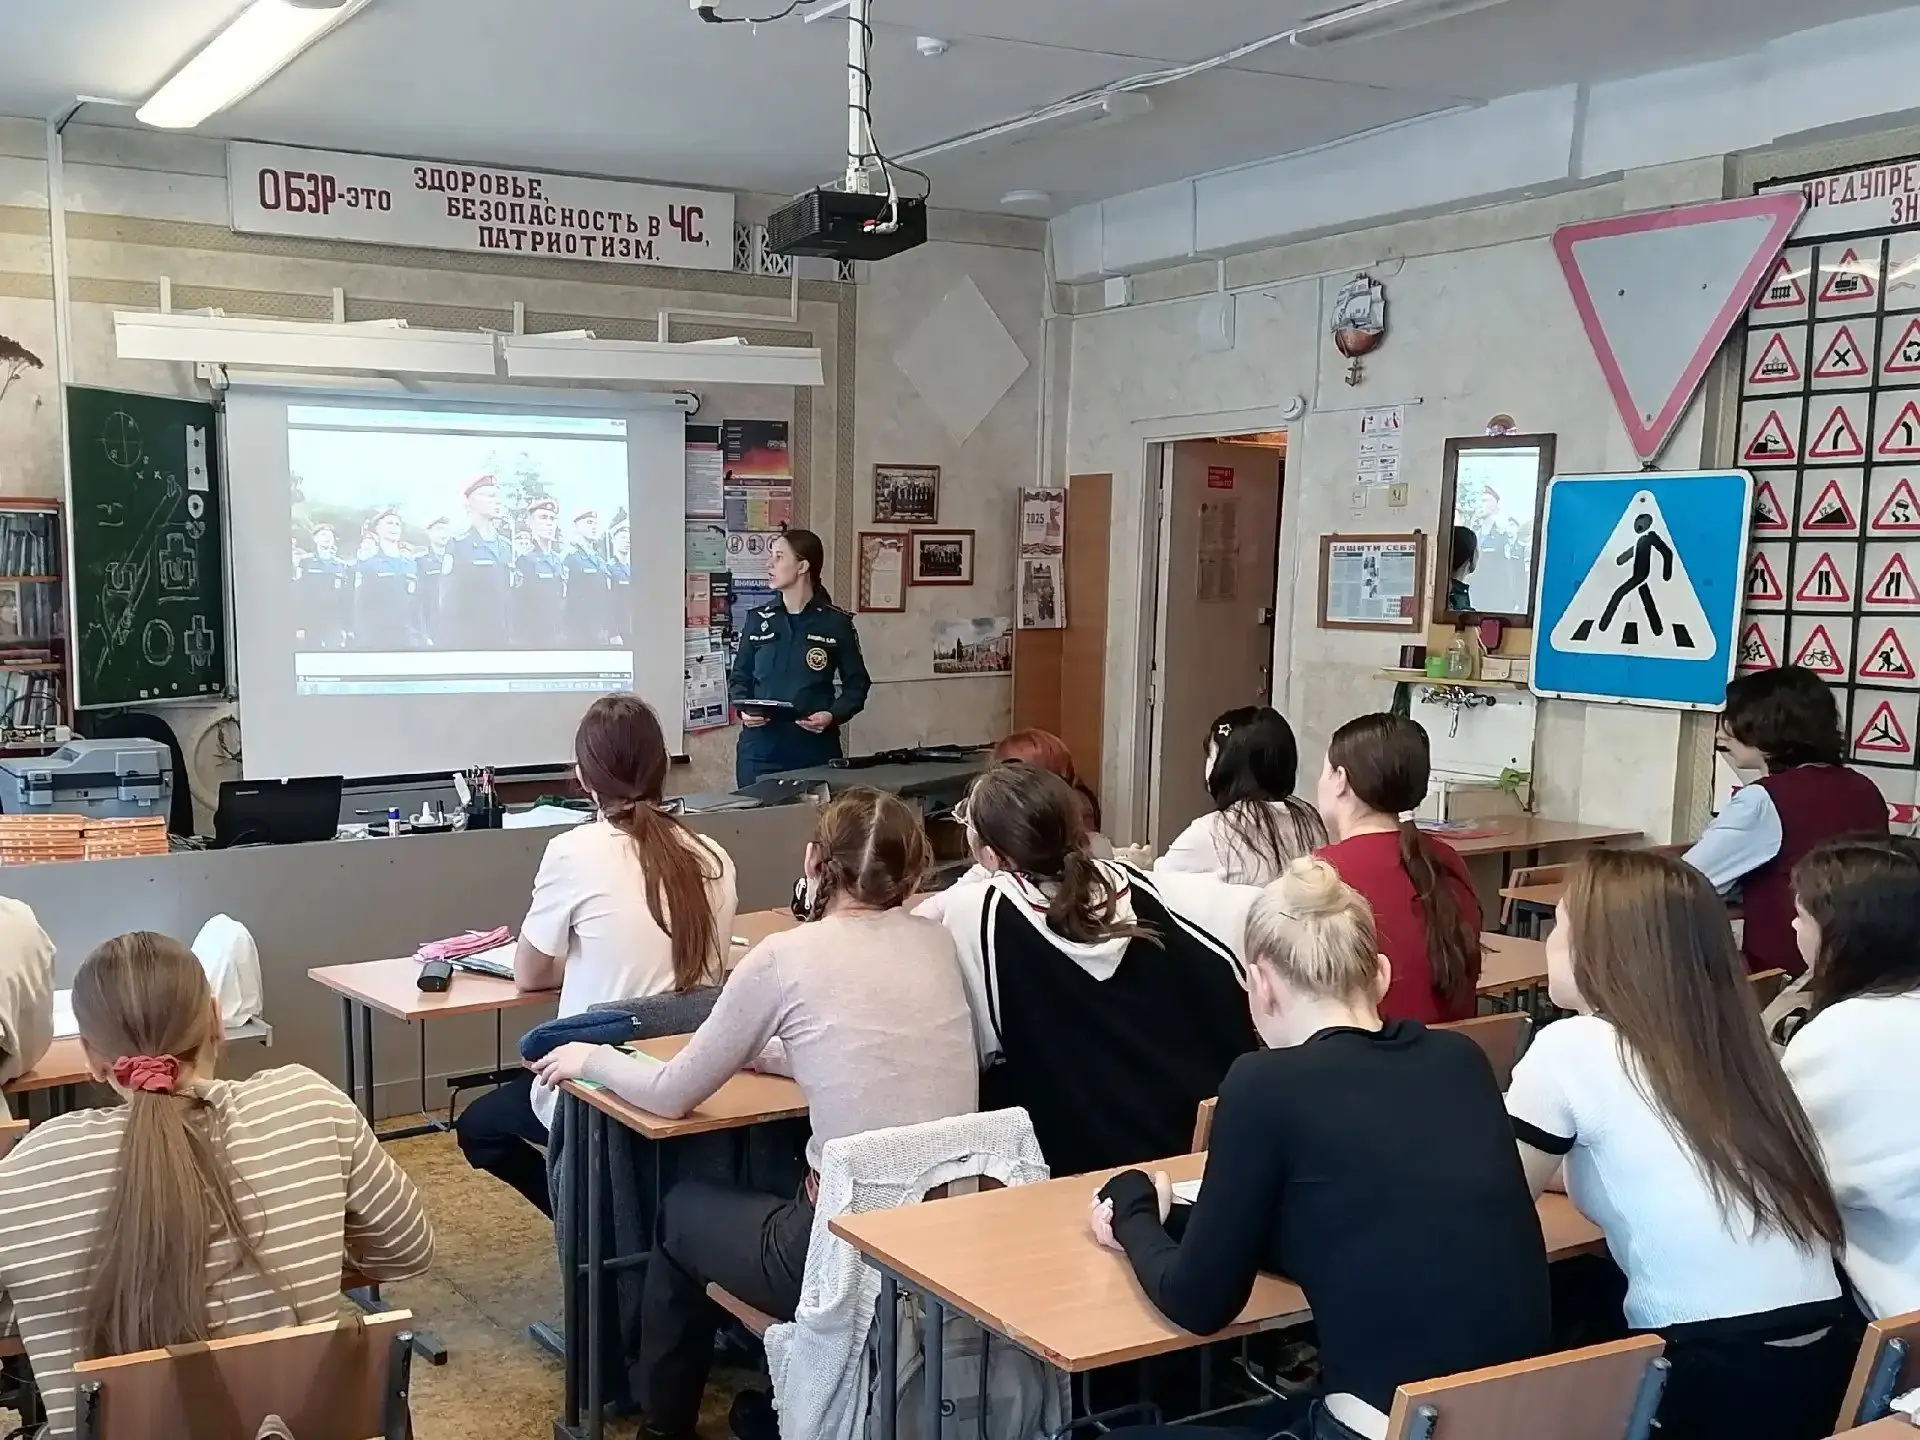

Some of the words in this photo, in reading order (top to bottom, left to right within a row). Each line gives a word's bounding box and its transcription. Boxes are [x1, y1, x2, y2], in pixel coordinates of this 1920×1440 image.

[258, 167, 392, 215] ОБЗР-ЭТО
[413, 167, 549, 204] ЗДОРОВЬЕ,
[1802, 164, 1920, 208] ПРЕДУПРЕ
[446, 196, 640, 234] БЕЗОПАСНОСТЬ
[667, 204, 710, 247] ЧС,
[478, 225, 661, 261] ПАТРИОТИЗМ.
[1026, 512, 1045, 524] 2025
[1331, 544, 1381, 552] ЗАЩИТИ
